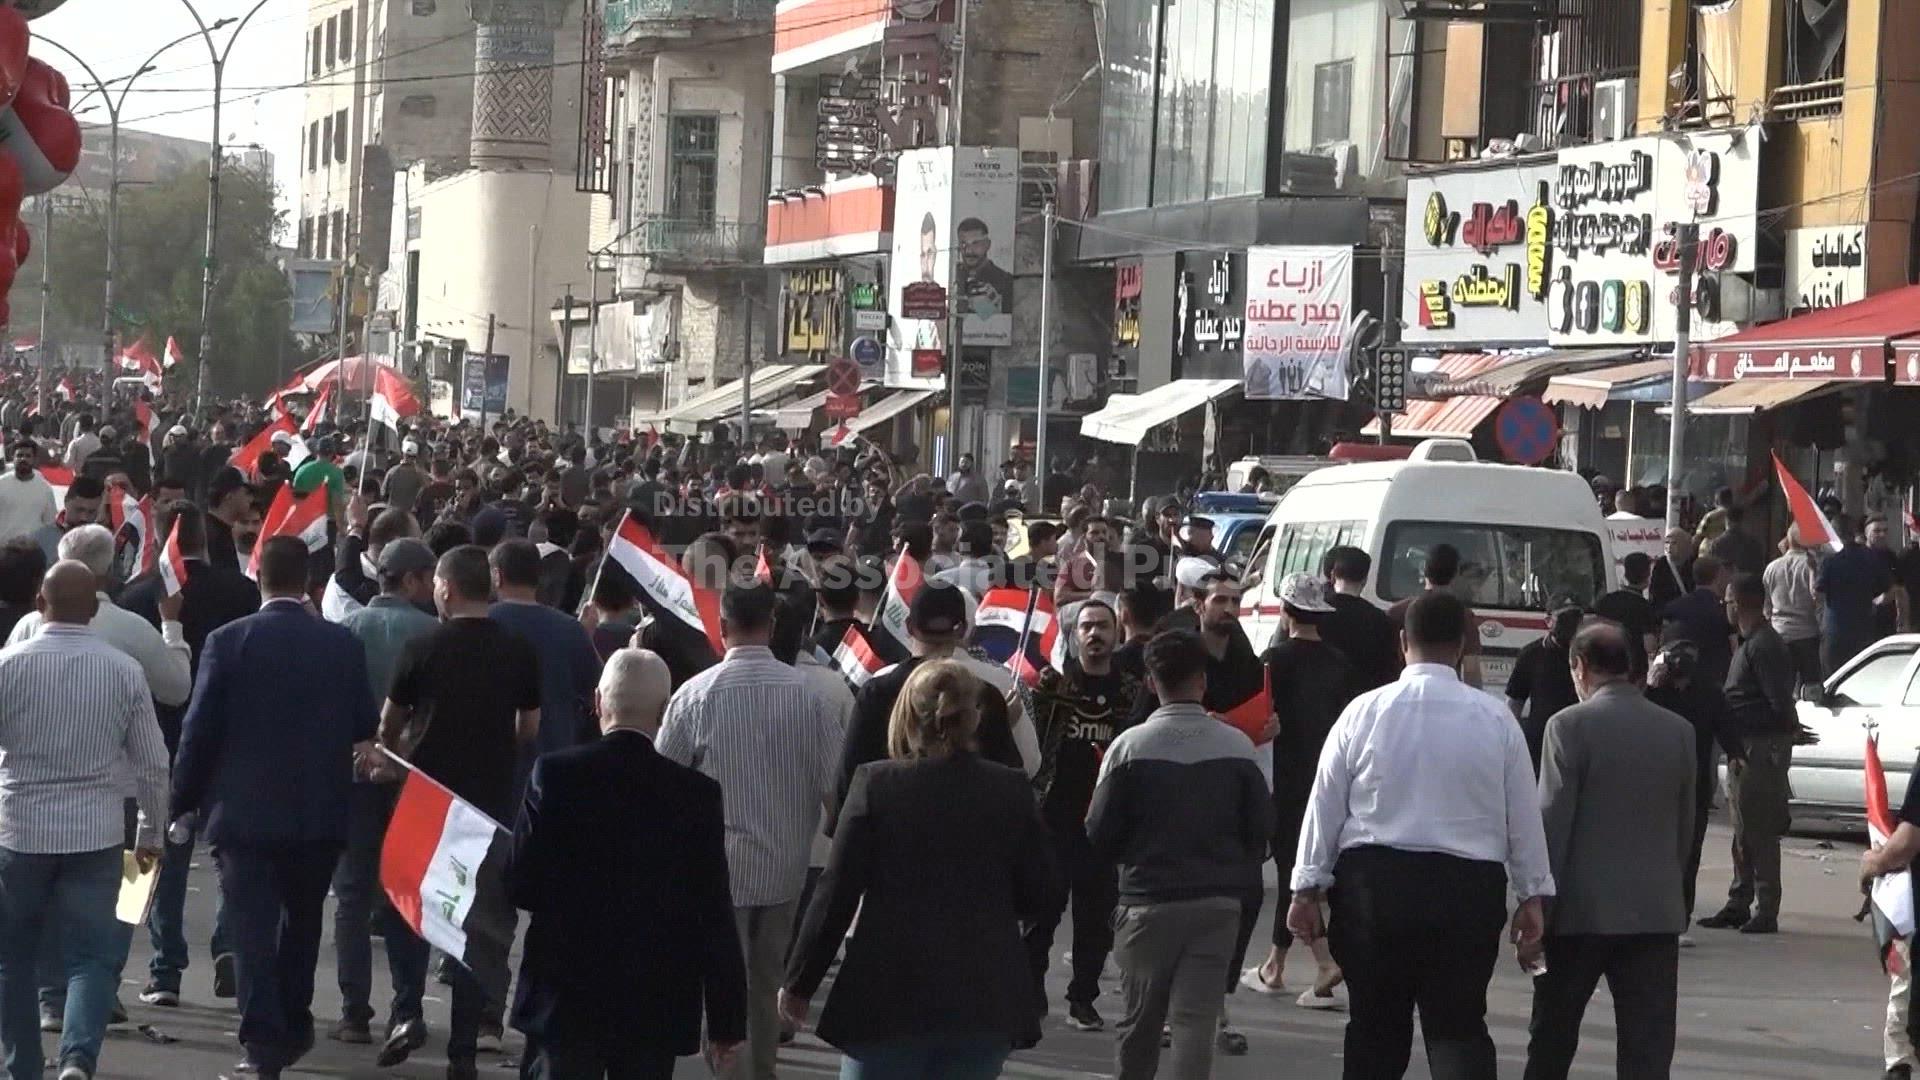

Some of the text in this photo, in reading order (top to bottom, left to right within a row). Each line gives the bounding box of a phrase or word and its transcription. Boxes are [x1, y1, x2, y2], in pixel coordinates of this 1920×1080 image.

[1597, 150, 1652, 202] الفردوس
[1812, 231, 1862, 276] كماليات
[1453, 264, 1520, 311] المصطفى
[1194, 308, 1241, 351] حيدر عطية
[1247, 299, 1341, 327] حيدر عطية
[1733, 350, 1835, 380] مطعم المذاق
